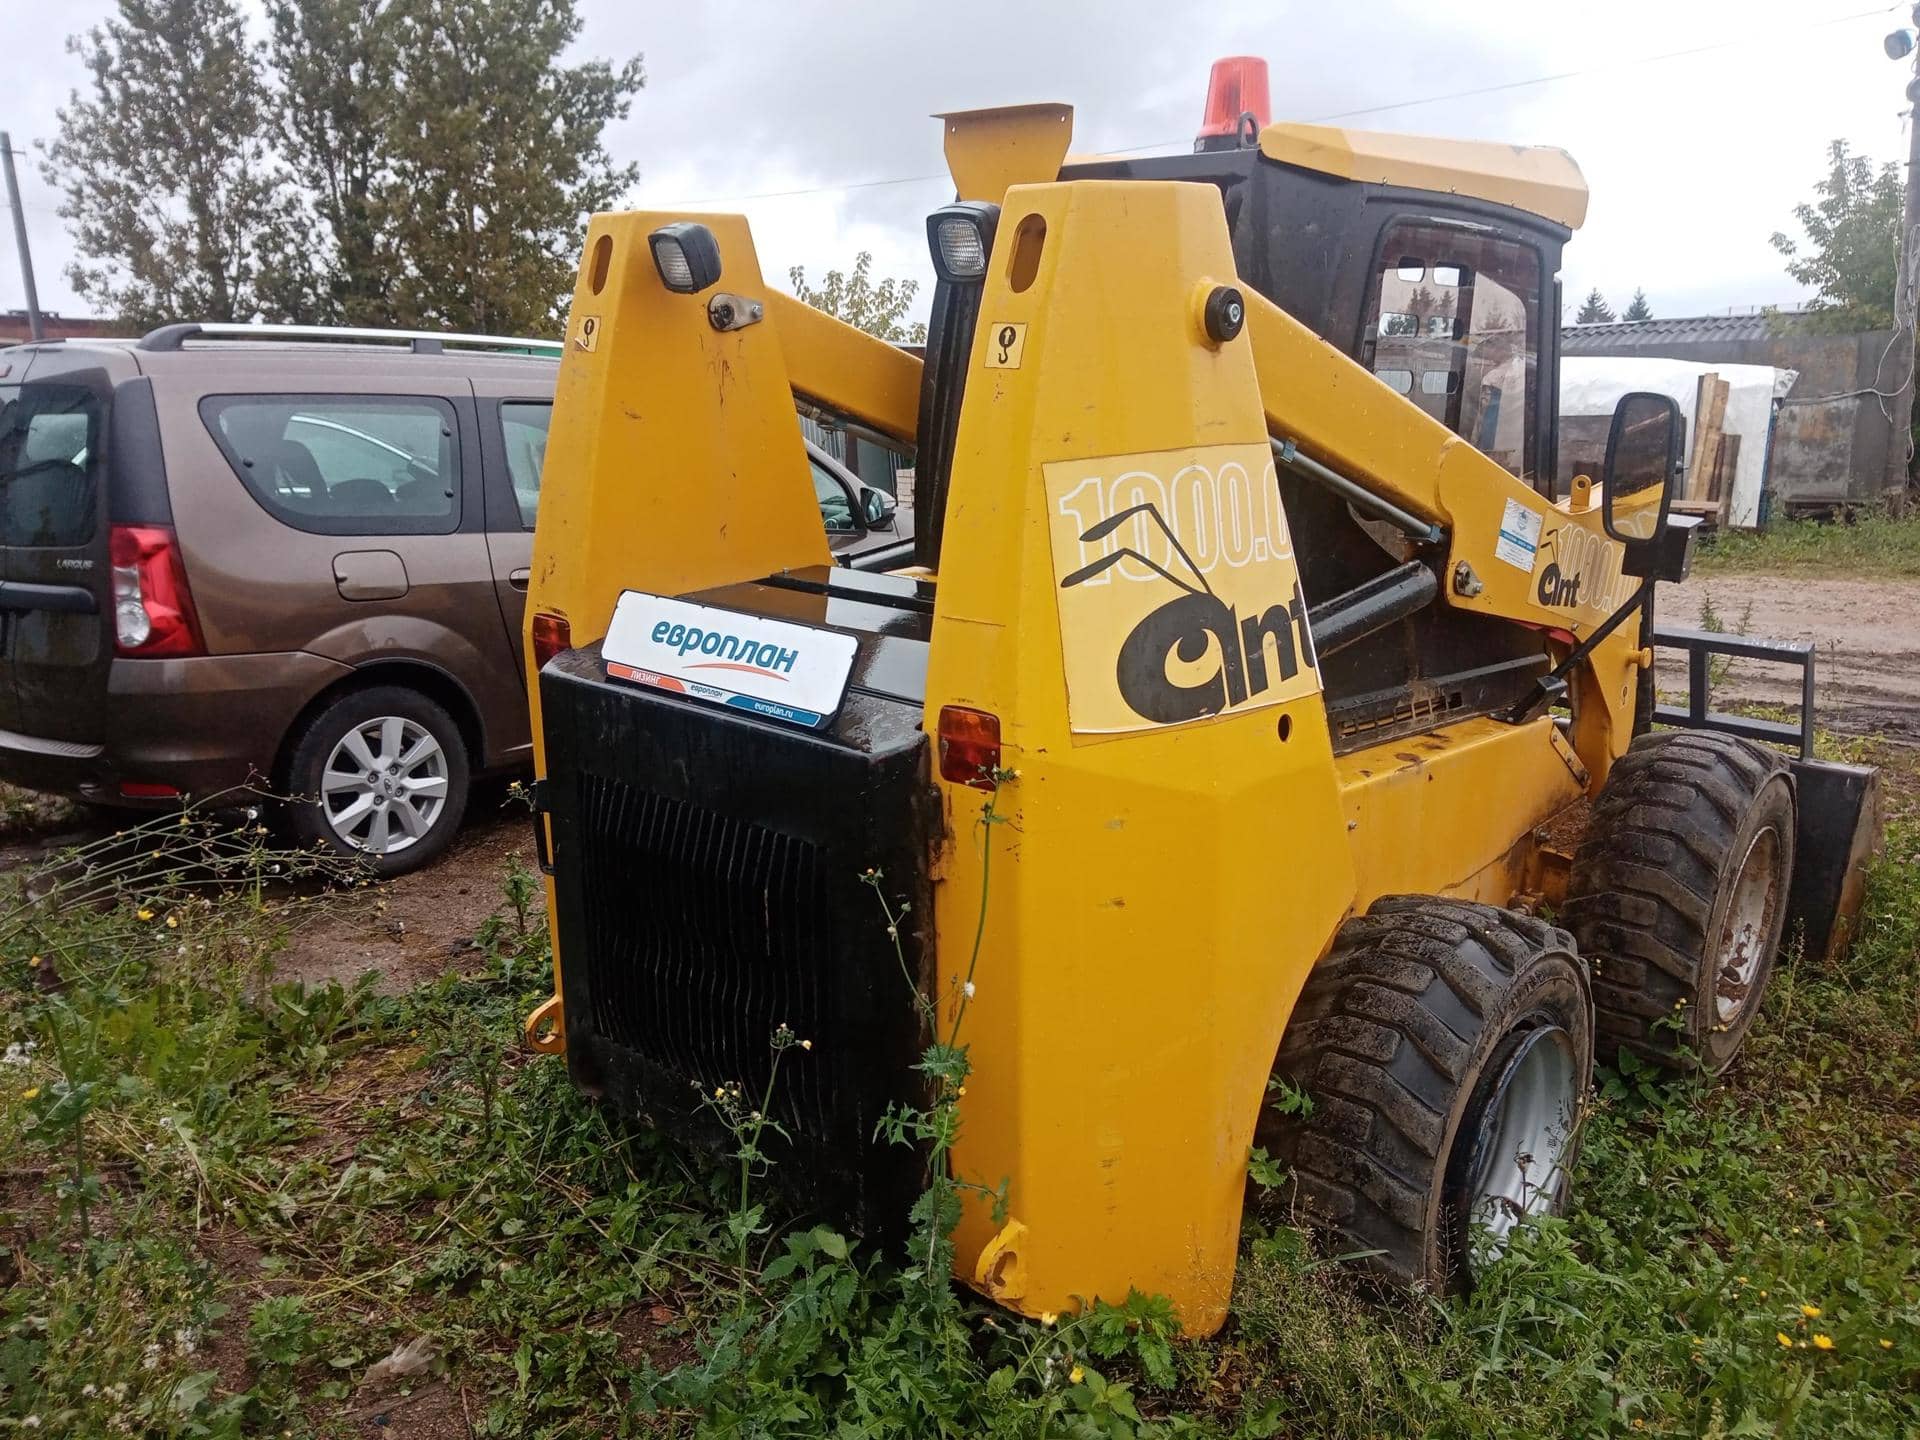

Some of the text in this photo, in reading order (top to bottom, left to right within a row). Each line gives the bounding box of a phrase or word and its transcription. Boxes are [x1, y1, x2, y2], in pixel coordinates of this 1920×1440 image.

[651, 620, 799, 673] европлан
[630, 669, 662, 685] ЛИЗИНГ
[690, 684, 723, 698] европлан
[754, 701, 794, 719] europlan.ru
